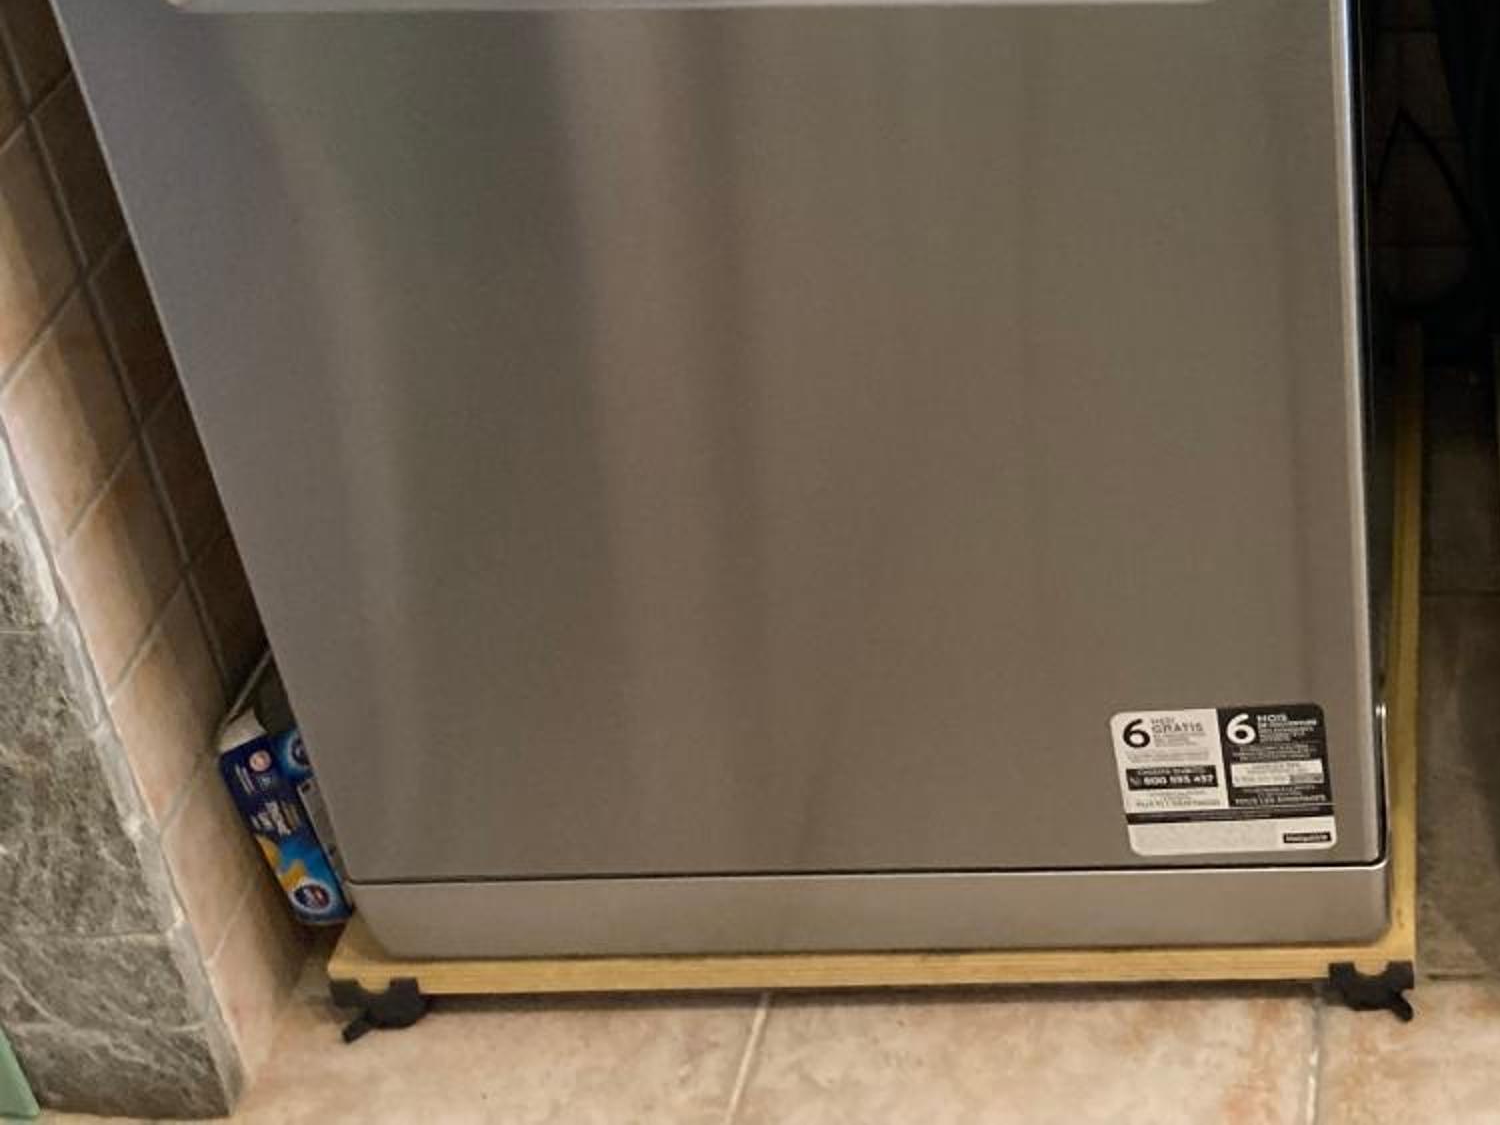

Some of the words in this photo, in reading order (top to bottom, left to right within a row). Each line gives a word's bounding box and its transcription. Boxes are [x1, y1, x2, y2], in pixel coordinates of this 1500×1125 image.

[1123, 718, 1151, 749] 6
[1151, 722, 1205, 733] GRATIS
[1227, 713, 1257, 745] 6
